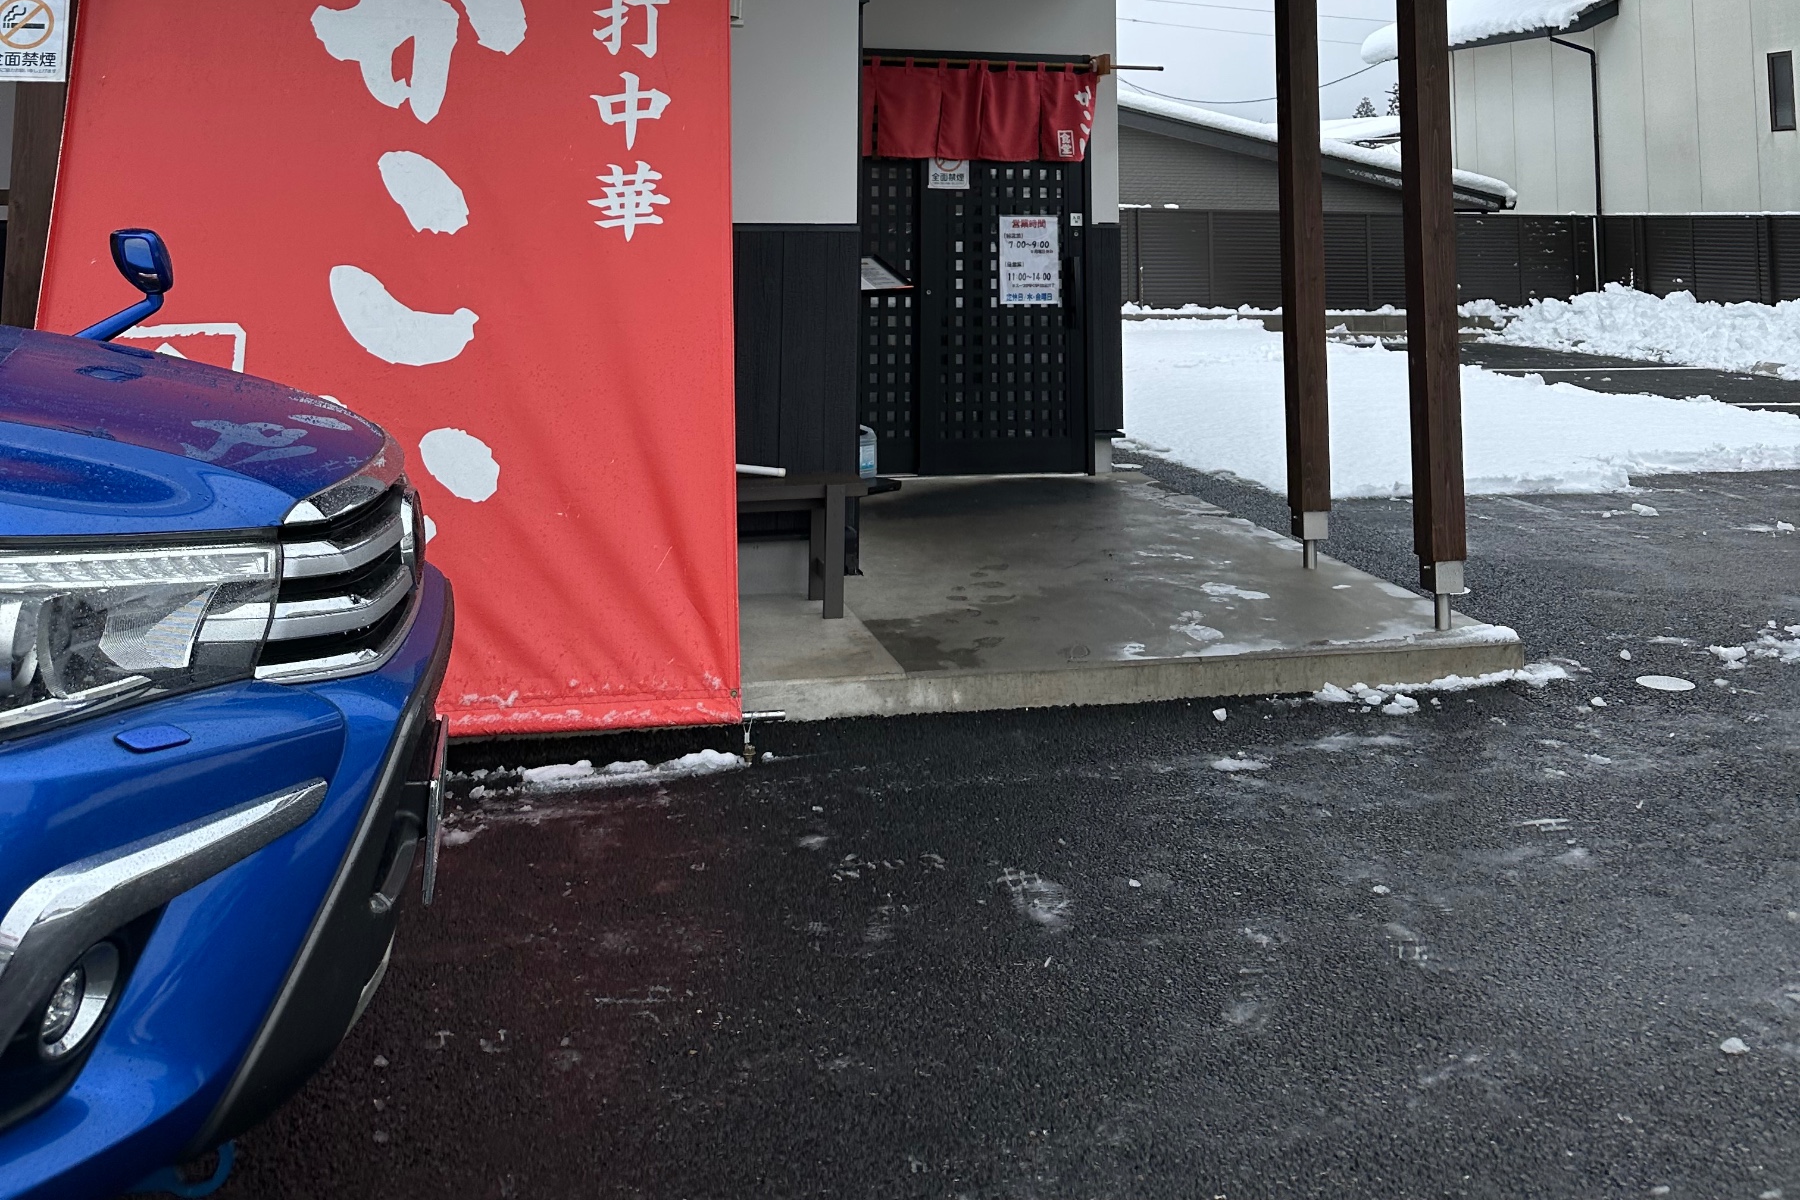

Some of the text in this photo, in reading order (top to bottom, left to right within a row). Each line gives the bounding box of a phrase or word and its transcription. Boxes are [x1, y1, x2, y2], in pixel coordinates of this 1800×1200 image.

[0, 51, 57, 68] 面禁煙
[1059, 132, 1073, 155] 食堂
[931, 172, 965, 182] 全面禁煙
[1012, 219, 1047, 229] 営業時間
